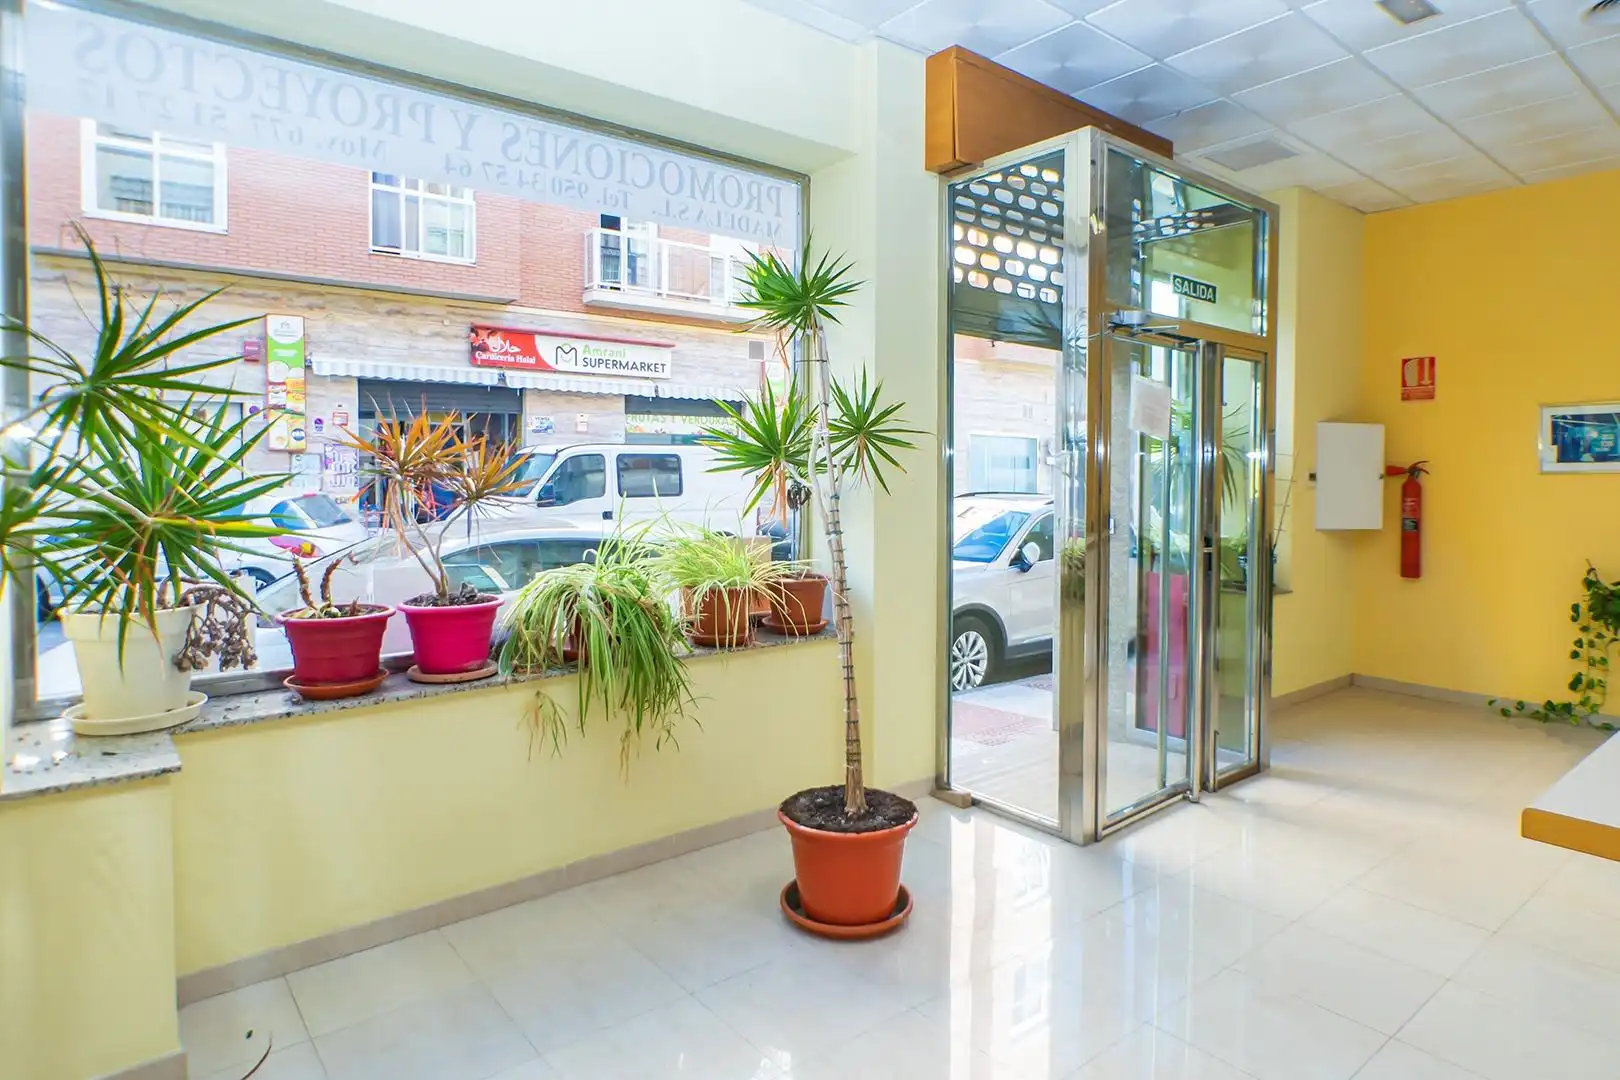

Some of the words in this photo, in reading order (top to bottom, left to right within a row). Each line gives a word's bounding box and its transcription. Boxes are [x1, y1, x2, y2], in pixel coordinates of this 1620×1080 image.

[1174, 278, 1214, 302] SALIDA
[582, 343, 626, 358] Amrani
[516, 354, 536, 364] Halal
[582, 357, 666, 373] SUPERMARKET
[626, 413, 666, 424] FRUTAS
[681, 416, 735, 425] VERDURAS
